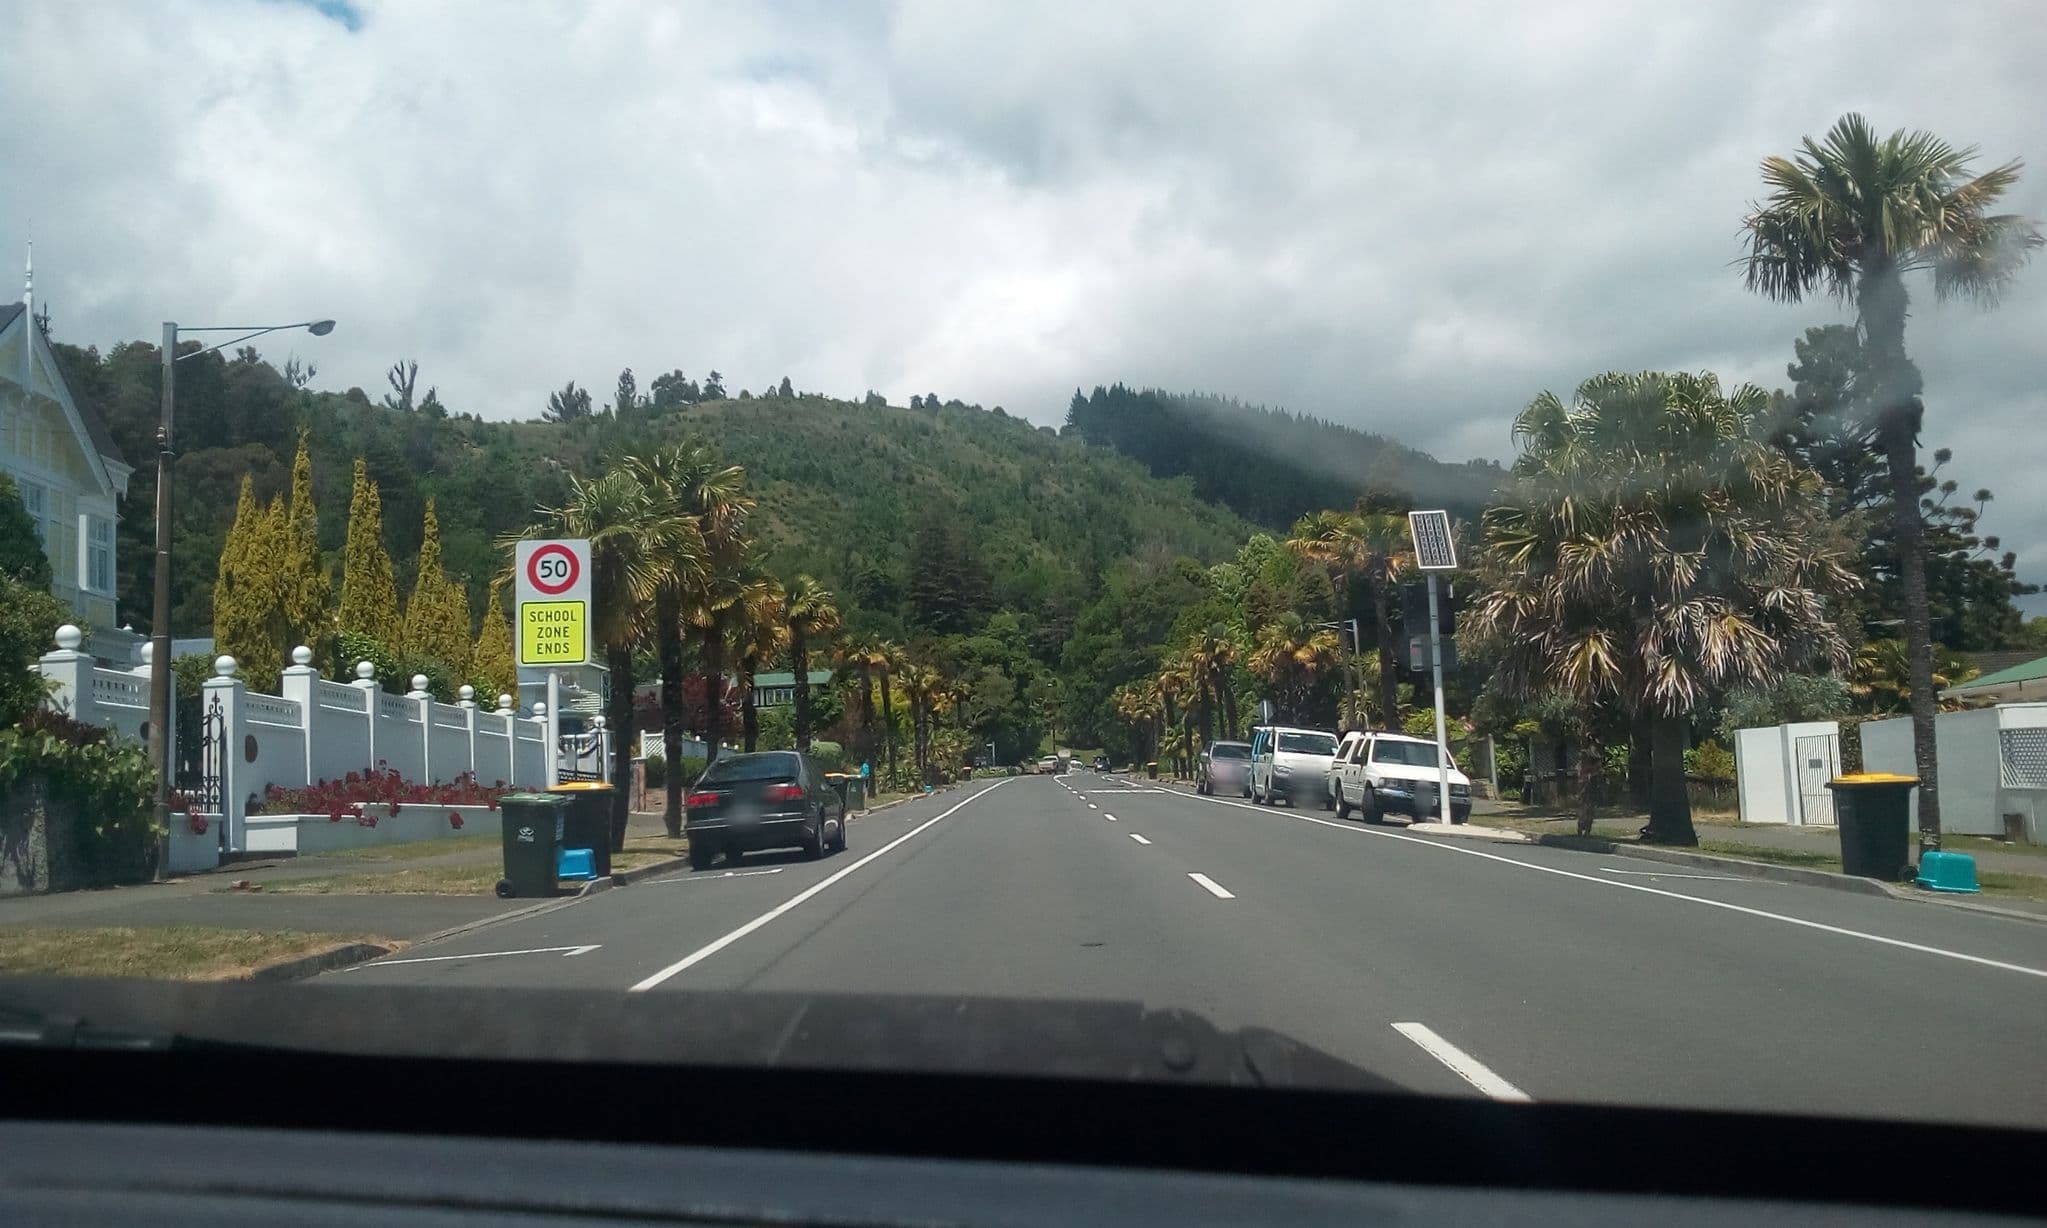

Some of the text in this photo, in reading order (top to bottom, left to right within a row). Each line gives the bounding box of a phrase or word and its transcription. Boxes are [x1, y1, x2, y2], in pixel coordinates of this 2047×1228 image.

[540, 560, 568, 578] 50
[529, 610, 577, 622] SCHOOL
[537, 626, 570, 639] ZONE
[536, 642, 570, 655] ENDS
